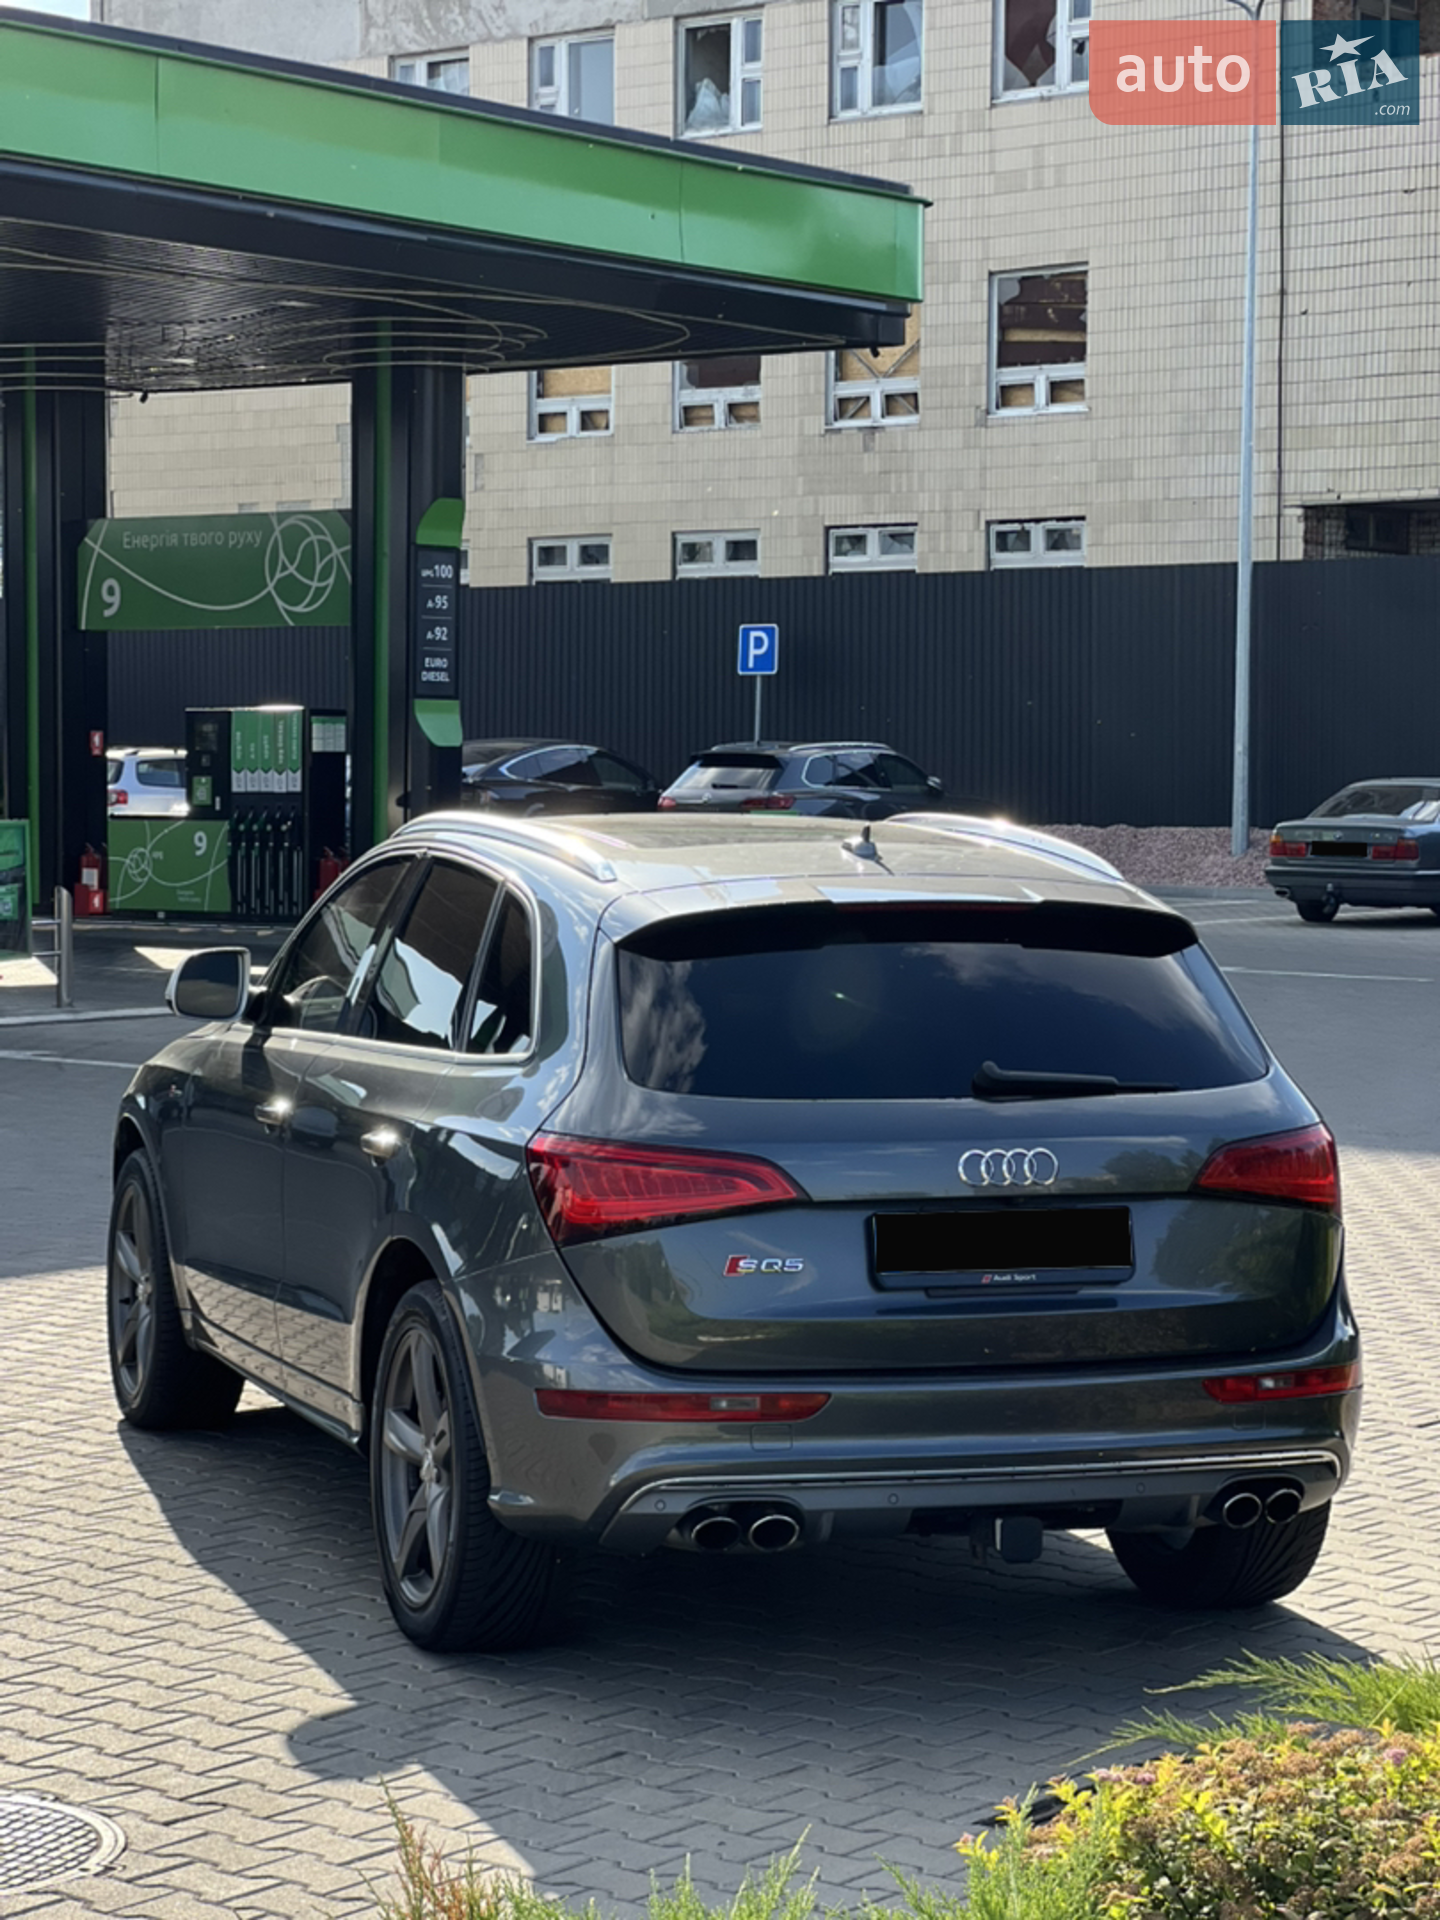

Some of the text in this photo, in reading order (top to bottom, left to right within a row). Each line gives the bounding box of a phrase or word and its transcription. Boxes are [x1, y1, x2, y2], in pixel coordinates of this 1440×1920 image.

[122, 529, 263, 551] Енергія твого руху
[101, 577, 121, 618] 9
[748, 630, 769, 669] P
[424, 657, 449, 669] EURO
[420, 671, 451, 682] DIESEL
[193, 830, 208, 857] 9
[736, 1257, 804, 1274] SQ5
[993, 1273, 1037, 1282] Audi Sport
